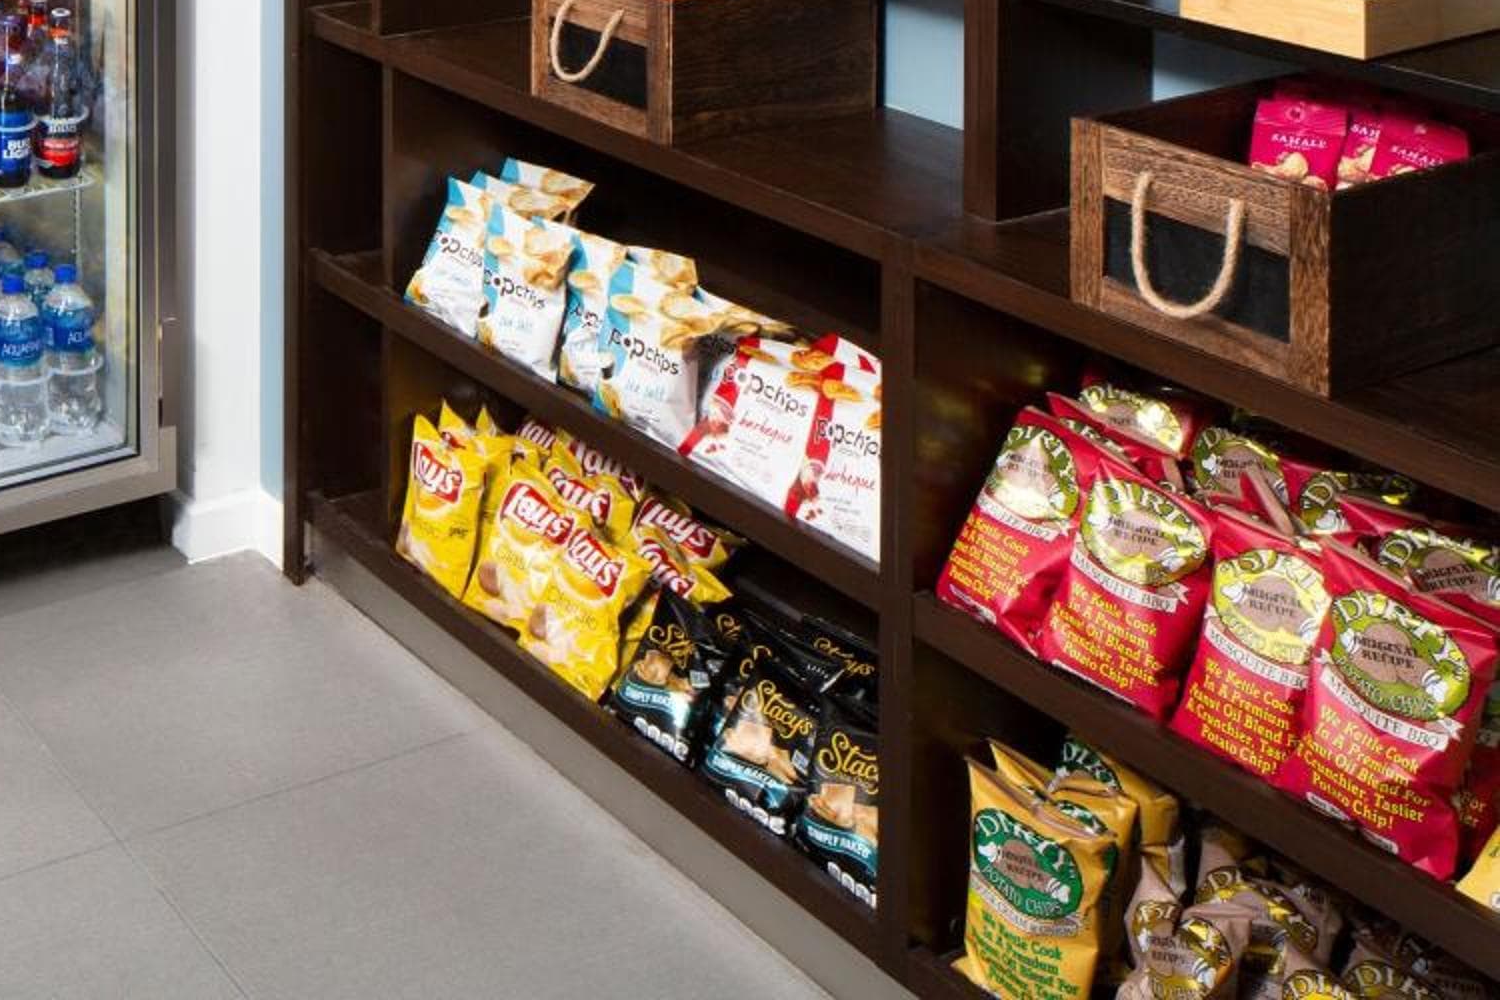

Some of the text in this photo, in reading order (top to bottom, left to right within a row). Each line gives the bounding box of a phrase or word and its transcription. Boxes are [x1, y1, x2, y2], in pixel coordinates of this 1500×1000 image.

[1350, 123, 1381, 139] SAH
[608, 327, 681, 377] popchips
[722, 362, 809, 418] popchips
[815, 419, 880, 457] popchip
[501, 484, 573, 538] Lay's
[641, 503, 715, 549] Lay's
[568, 529, 624, 588] Lay's
[1140, 590, 1174, 609] BBQ
[1125, 612, 1157, 637] Cook
[1099, 662, 1135, 690] Chip!
[1119, 655, 1159, 687] Tastie
[1225, 668, 1261, 698] Kettle
[741, 679, 813, 739] Stacy's
[1217, 683, 1229, 699] A
[1231, 691, 1291, 731] Premium
[1223, 703, 1243, 722] Oil
[1244, 714, 1284, 744] Blend
[1326, 674, 1441, 748] MESQUITE BBQ
[818, 731, 879, 795] Stac
[1201, 722, 1278, 775] Potato Chip!
[1259, 738, 1287, 763] Tast
[1332, 735, 1345, 750] A
[1348, 743, 1410, 787] Premium
[1342, 721, 1384, 754] Kettle
[1385, 745, 1420, 775] Cook
[1312, 770, 1395, 831] Potato Chip!
[1334, 753, 1432, 809] Oil Blend For
[1374, 791, 1425, 824] Tastier
[1030, 940, 1062, 960] Cook
